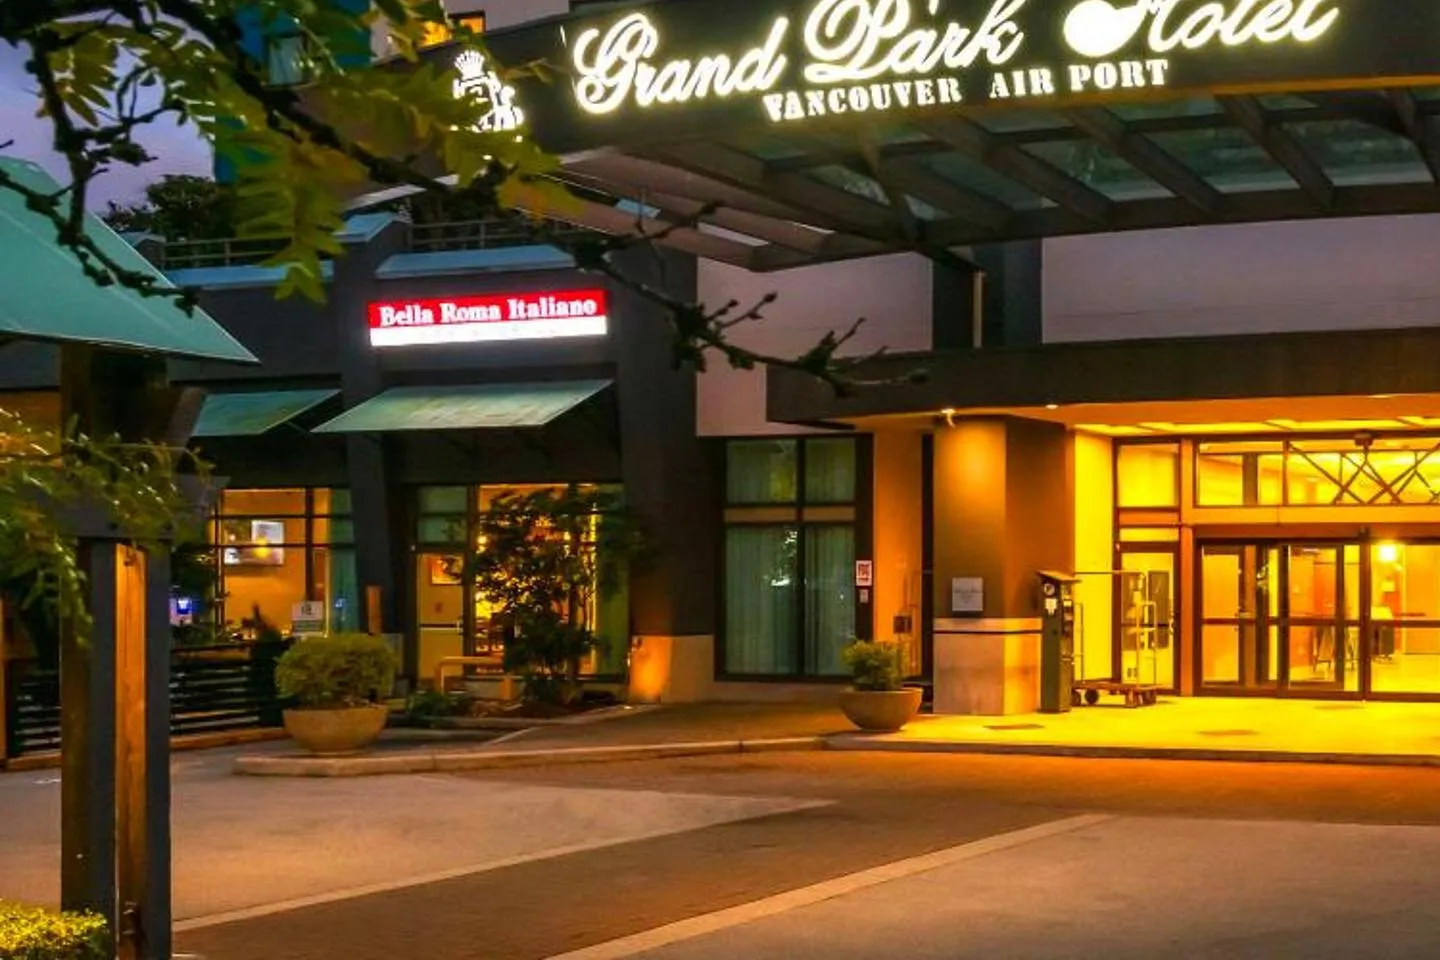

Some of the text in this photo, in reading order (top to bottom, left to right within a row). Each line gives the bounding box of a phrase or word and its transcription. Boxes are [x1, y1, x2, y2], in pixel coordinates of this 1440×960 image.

[572, 11, 790, 115] Grand
[762, 57, 1169, 123] VANCOUVER AIR PORT
[379, 296, 597, 328] Bella Roma Italiano
